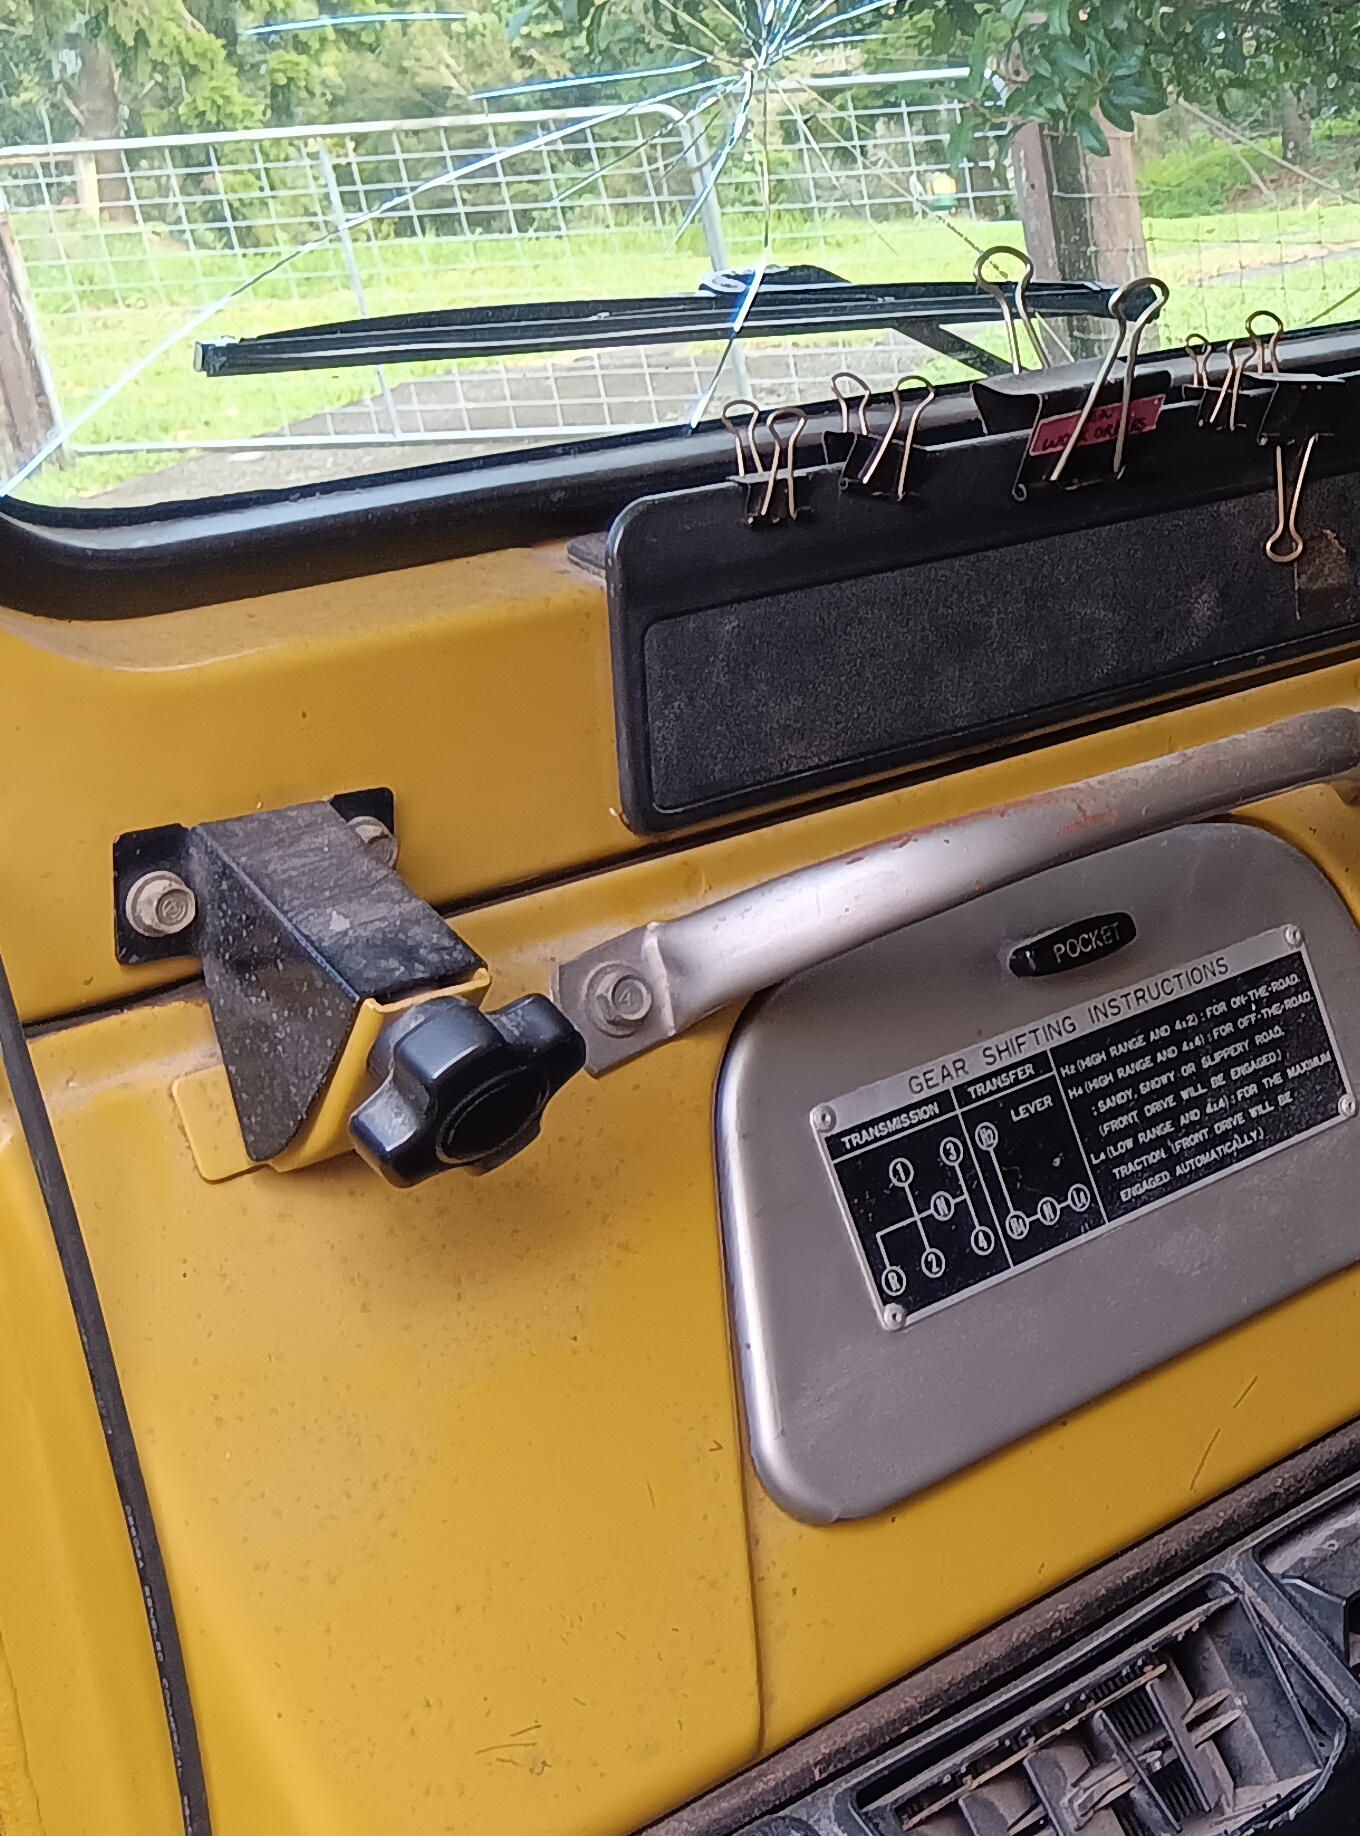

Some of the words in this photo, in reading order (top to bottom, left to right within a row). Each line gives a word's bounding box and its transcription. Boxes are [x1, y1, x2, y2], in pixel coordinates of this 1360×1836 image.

[1053, 921, 1121, 964] POCKET
[908, 1058, 969, 1095] GEAR
[983, 1015, 1077, 1065] SHIFTING
[1088, 956, 1228, 1025] INSTRUCTIONS
[1077, 1051, 1106, 1072] (HIGH
[1109, 1035, 1147, 1056] RANGE
[1150, 1026, 1171, 1043] AND
[1206, 1002, 1227, 1018] FOR
[967, 1064, 1035, 1099] TRANSFER
[1085, 1073, 1114, 1094] (HIGH
[1117, 1056, 1154, 1078] RANGE
[1156, 1047, 1178, 1064] AND
[1213, 1022, 1234, 1039] FOR
[1139, 1071, 1175, 1094] SNOWY
[1181, 1062, 1196, 1077] OR
[1201, 1040, 1249, 1069] SLIPPERY
[1010, 1095, 1054, 1122] LEVER
[1099, 1110, 1138, 1137] (FRONT
[1144, 1095, 1177, 1117] DRIVE
[1180, 1084, 1207, 1101] WILL
[1210, 1073, 1226, 1089] BE
[1230, 1049, 1283, 1079] ENGAGED)
[1108, 1138, 1134, 1159] (LOW
[1138, 1123, 1175, 1145] RANGE
[1180, 1110, 1201, 1126] AND
[1236, 1085, 1258, 1101] FOR
[1262, 1075, 1283, 1090] THE
[1287, 1051, 1333, 1079] MAXIMUM
[1214, 1114, 1245, 1136] DRIVE
[1250, 1101, 1275, 1118] WILL
[1278, 1091, 1293, 1106] BE
[841, 1101, 940, 1150] TRANSMISSION
[1120, 1172, 1171, 1203] ENGAGED
